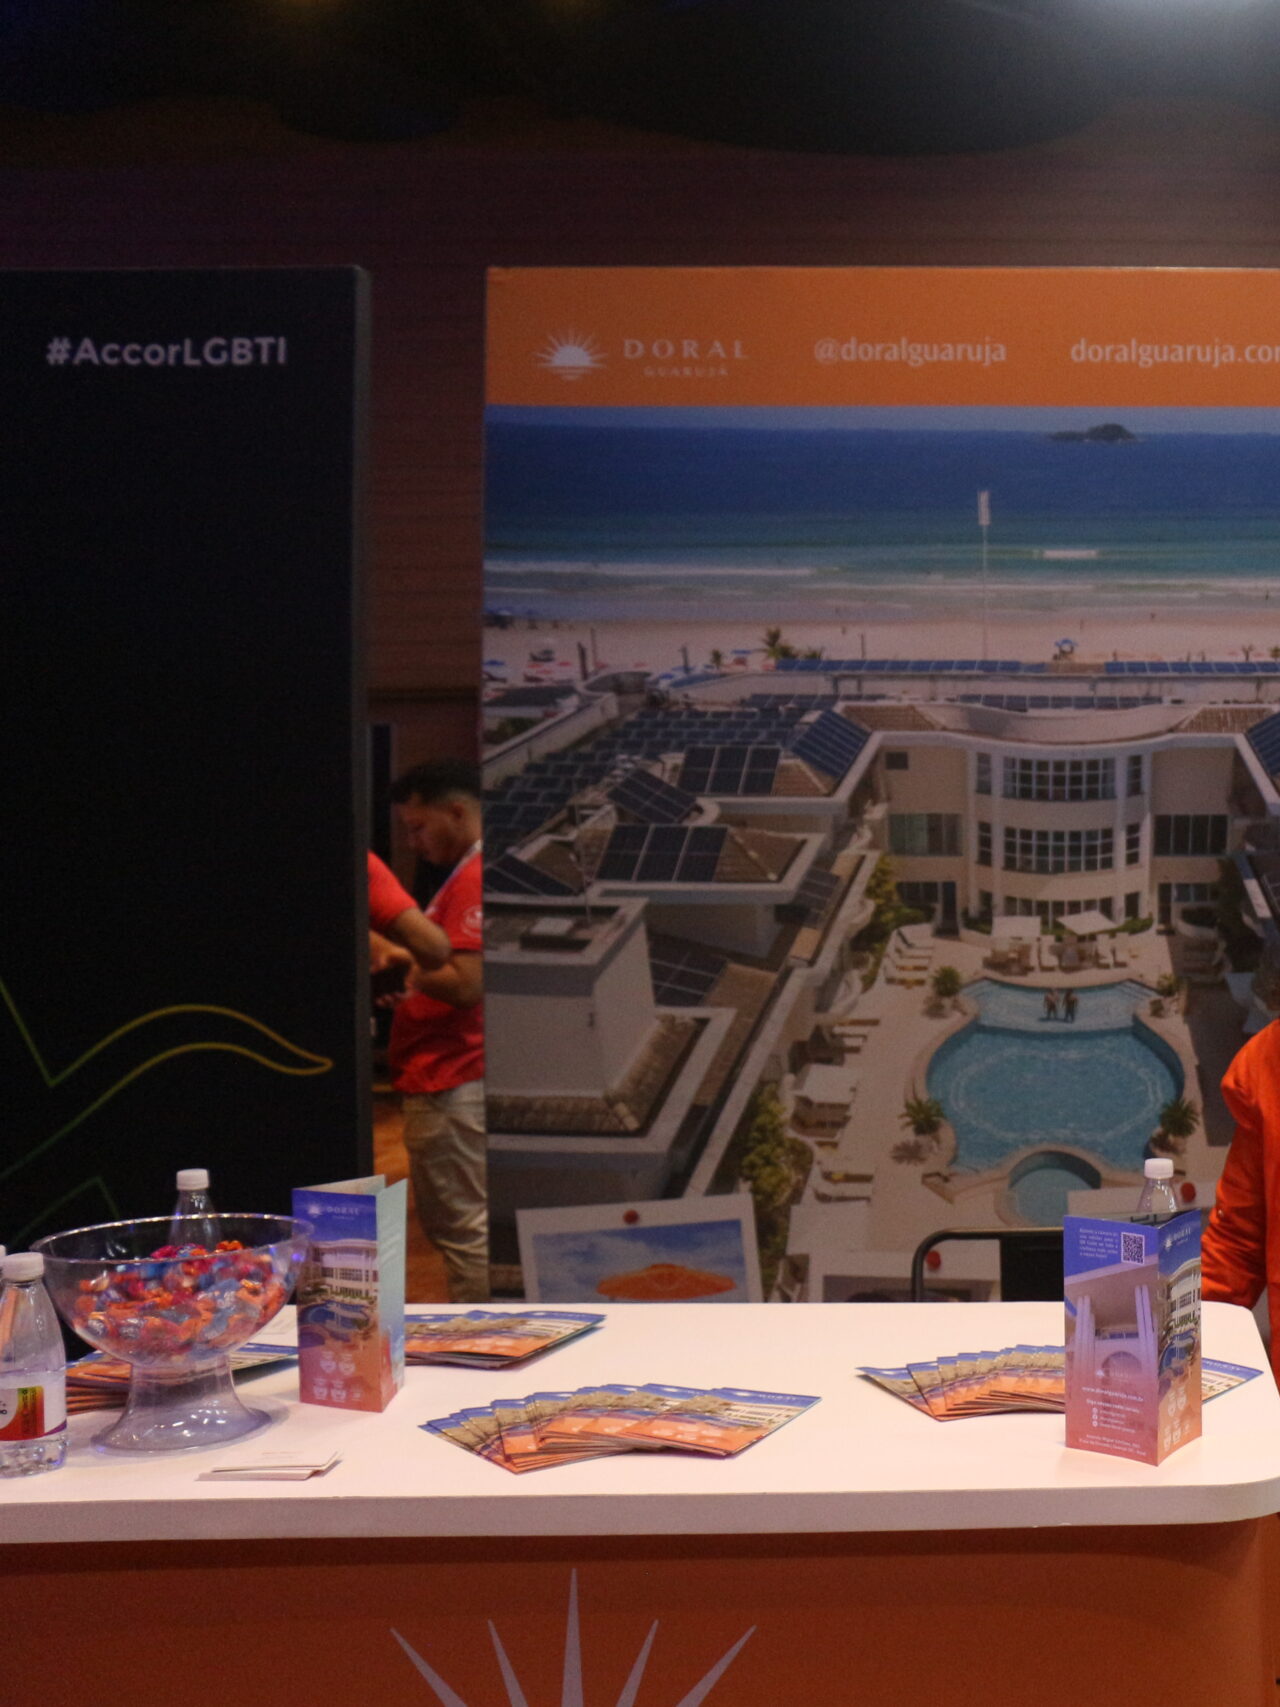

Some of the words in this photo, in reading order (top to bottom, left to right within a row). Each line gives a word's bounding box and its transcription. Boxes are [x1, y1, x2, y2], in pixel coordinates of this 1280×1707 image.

[46, 336, 287, 366] #AccorLGBTI
[623, 338, 749, 360] DORAL
[813, 337, 1007, 366] @doralguaruja
